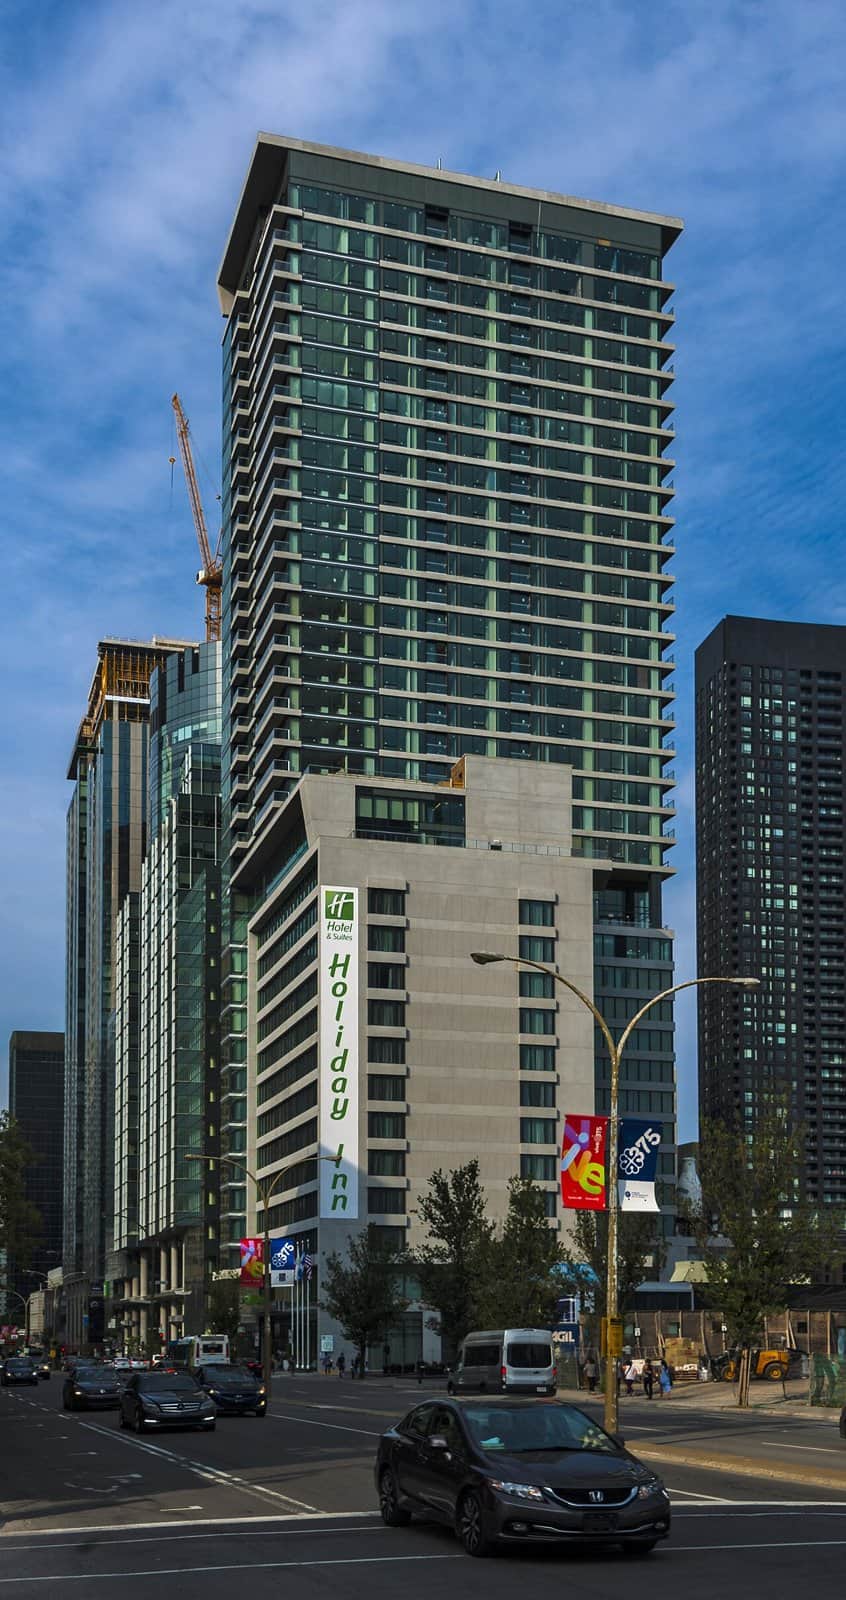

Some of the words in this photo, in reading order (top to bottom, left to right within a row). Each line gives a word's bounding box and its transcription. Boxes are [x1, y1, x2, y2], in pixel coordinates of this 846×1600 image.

[327, 921, 353, 933] Hotel
[333, 933, 353, 941] Suites
[328, 953, 351, 1121] Holiday
[628, 1127, 661, 1164] 375
[331, 1143, 348, 1212] Inn
